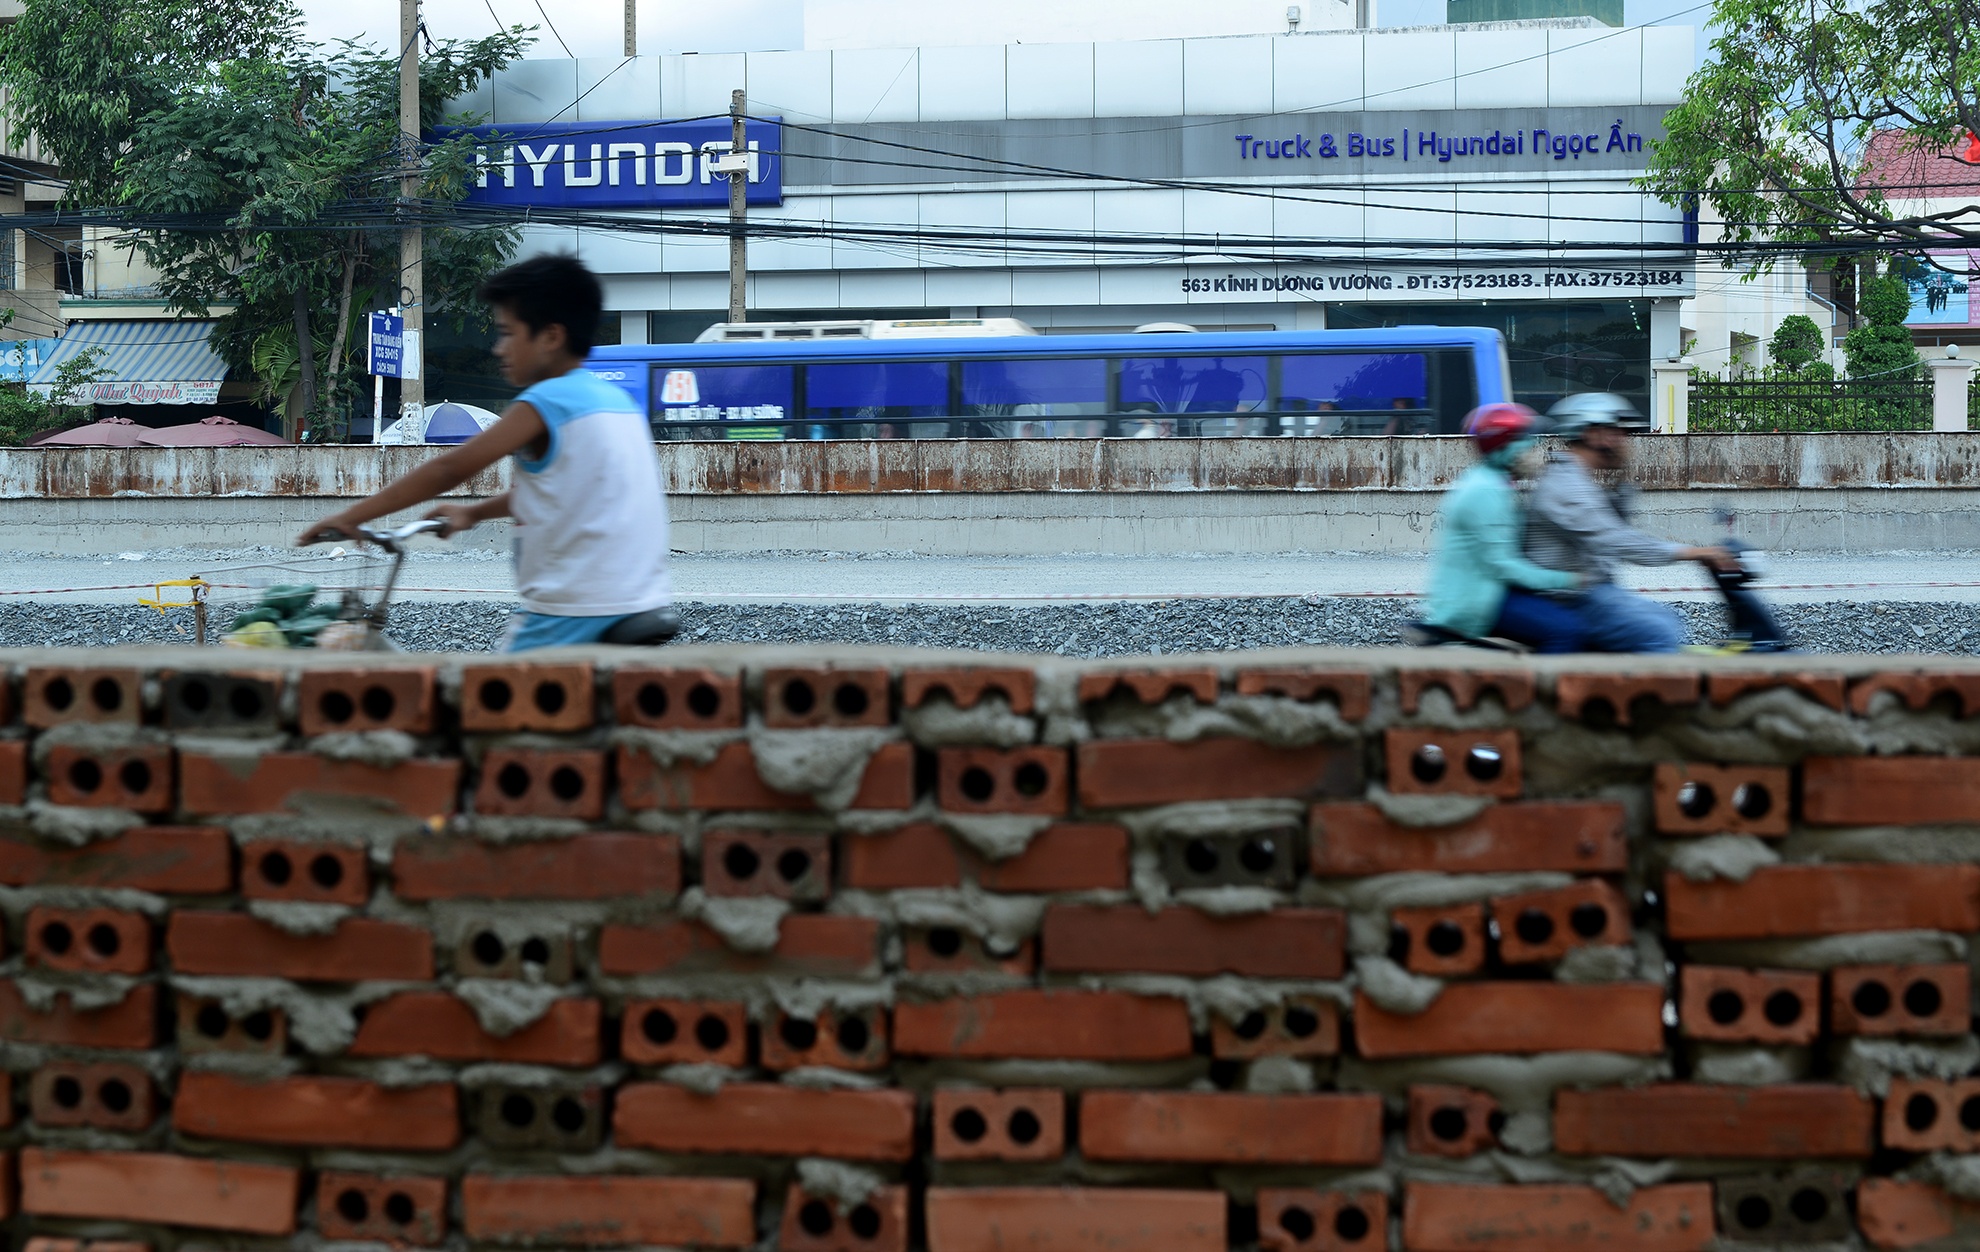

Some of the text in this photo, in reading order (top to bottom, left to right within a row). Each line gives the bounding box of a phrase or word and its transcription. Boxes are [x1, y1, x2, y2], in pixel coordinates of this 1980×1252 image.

[1235, 133, 1311, 159] Truck
[1319, 133, 1339, 158] &
[1348, 132, 1395, 157] Bus
[1418, 129, 1523, 162] Hyundai
[475, 140, 759, 188] HYUNDAI
[1181, 278, 1211, 293] 563
[1262, 274, 1324, 292] DƯƠNG
[1328, 273, 1392, 291] VƯƠNG
